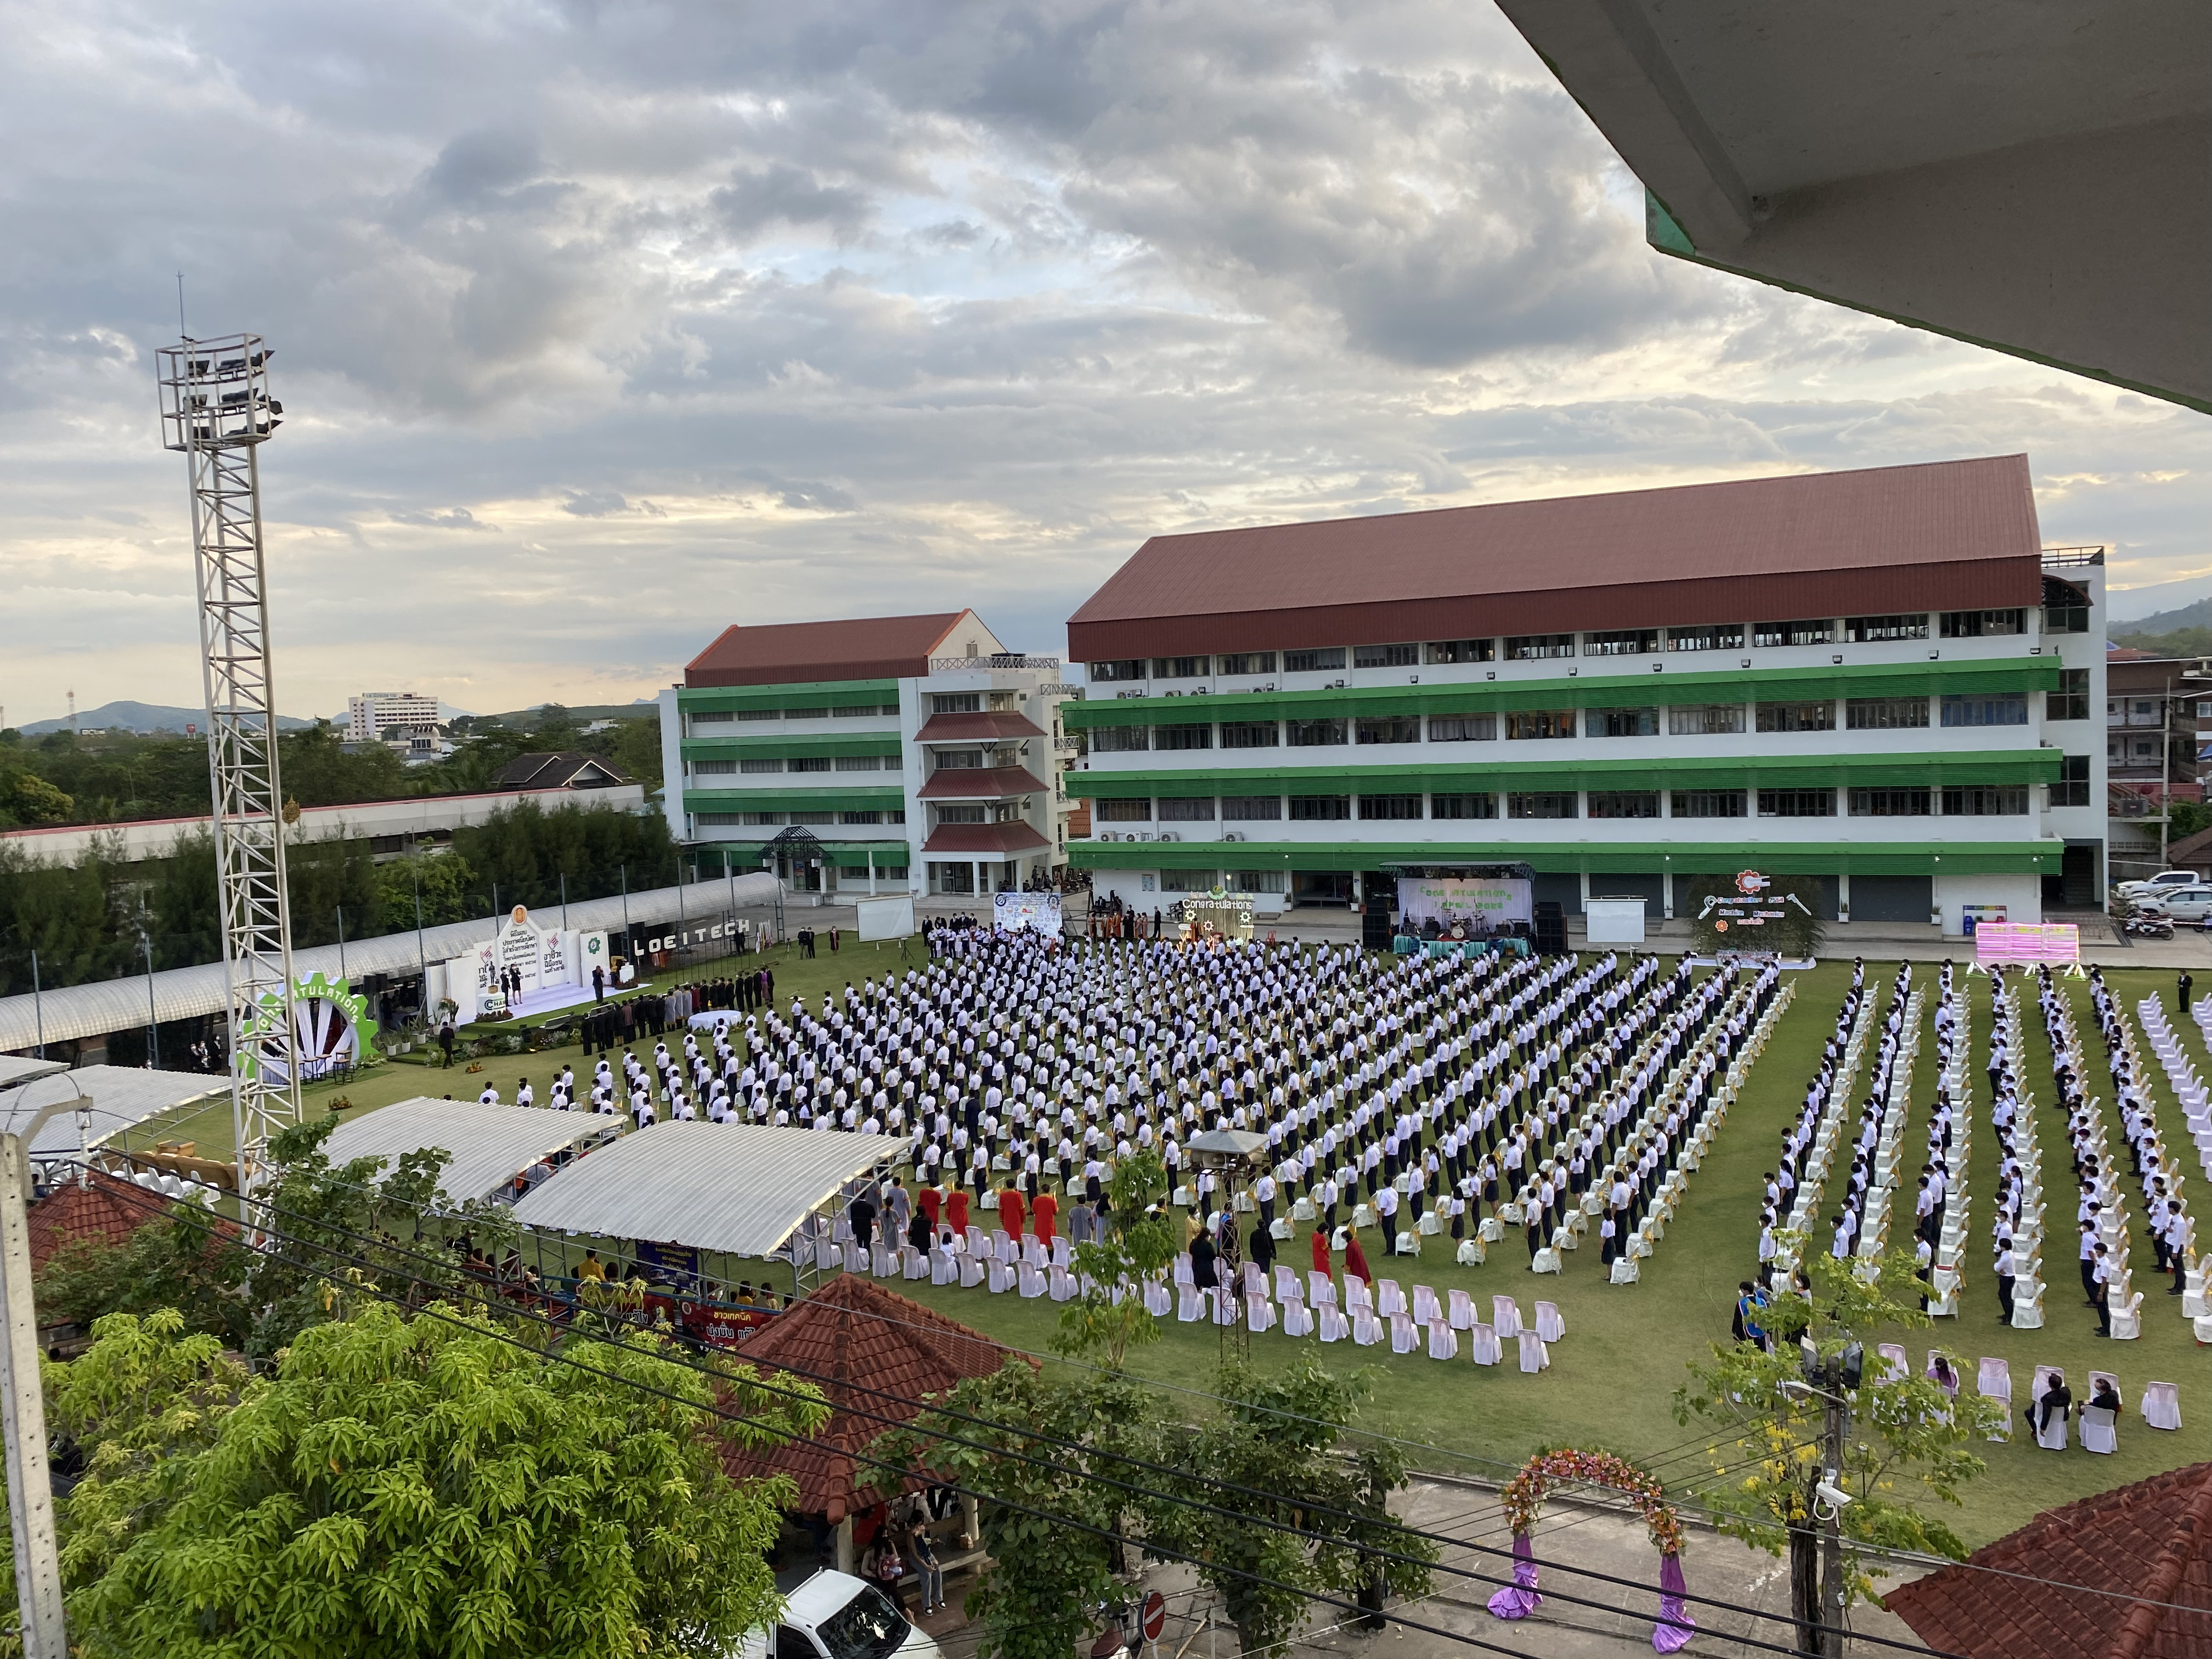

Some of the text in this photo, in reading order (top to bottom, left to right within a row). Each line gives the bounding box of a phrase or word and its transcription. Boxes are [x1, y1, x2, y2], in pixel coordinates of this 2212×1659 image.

[1182, 899, 1252, 910] Congratulations
[259, 985, 359, 1028] ONGATULATIONS
[714, 1310, 751, 1322] ชาวเทคนิค
